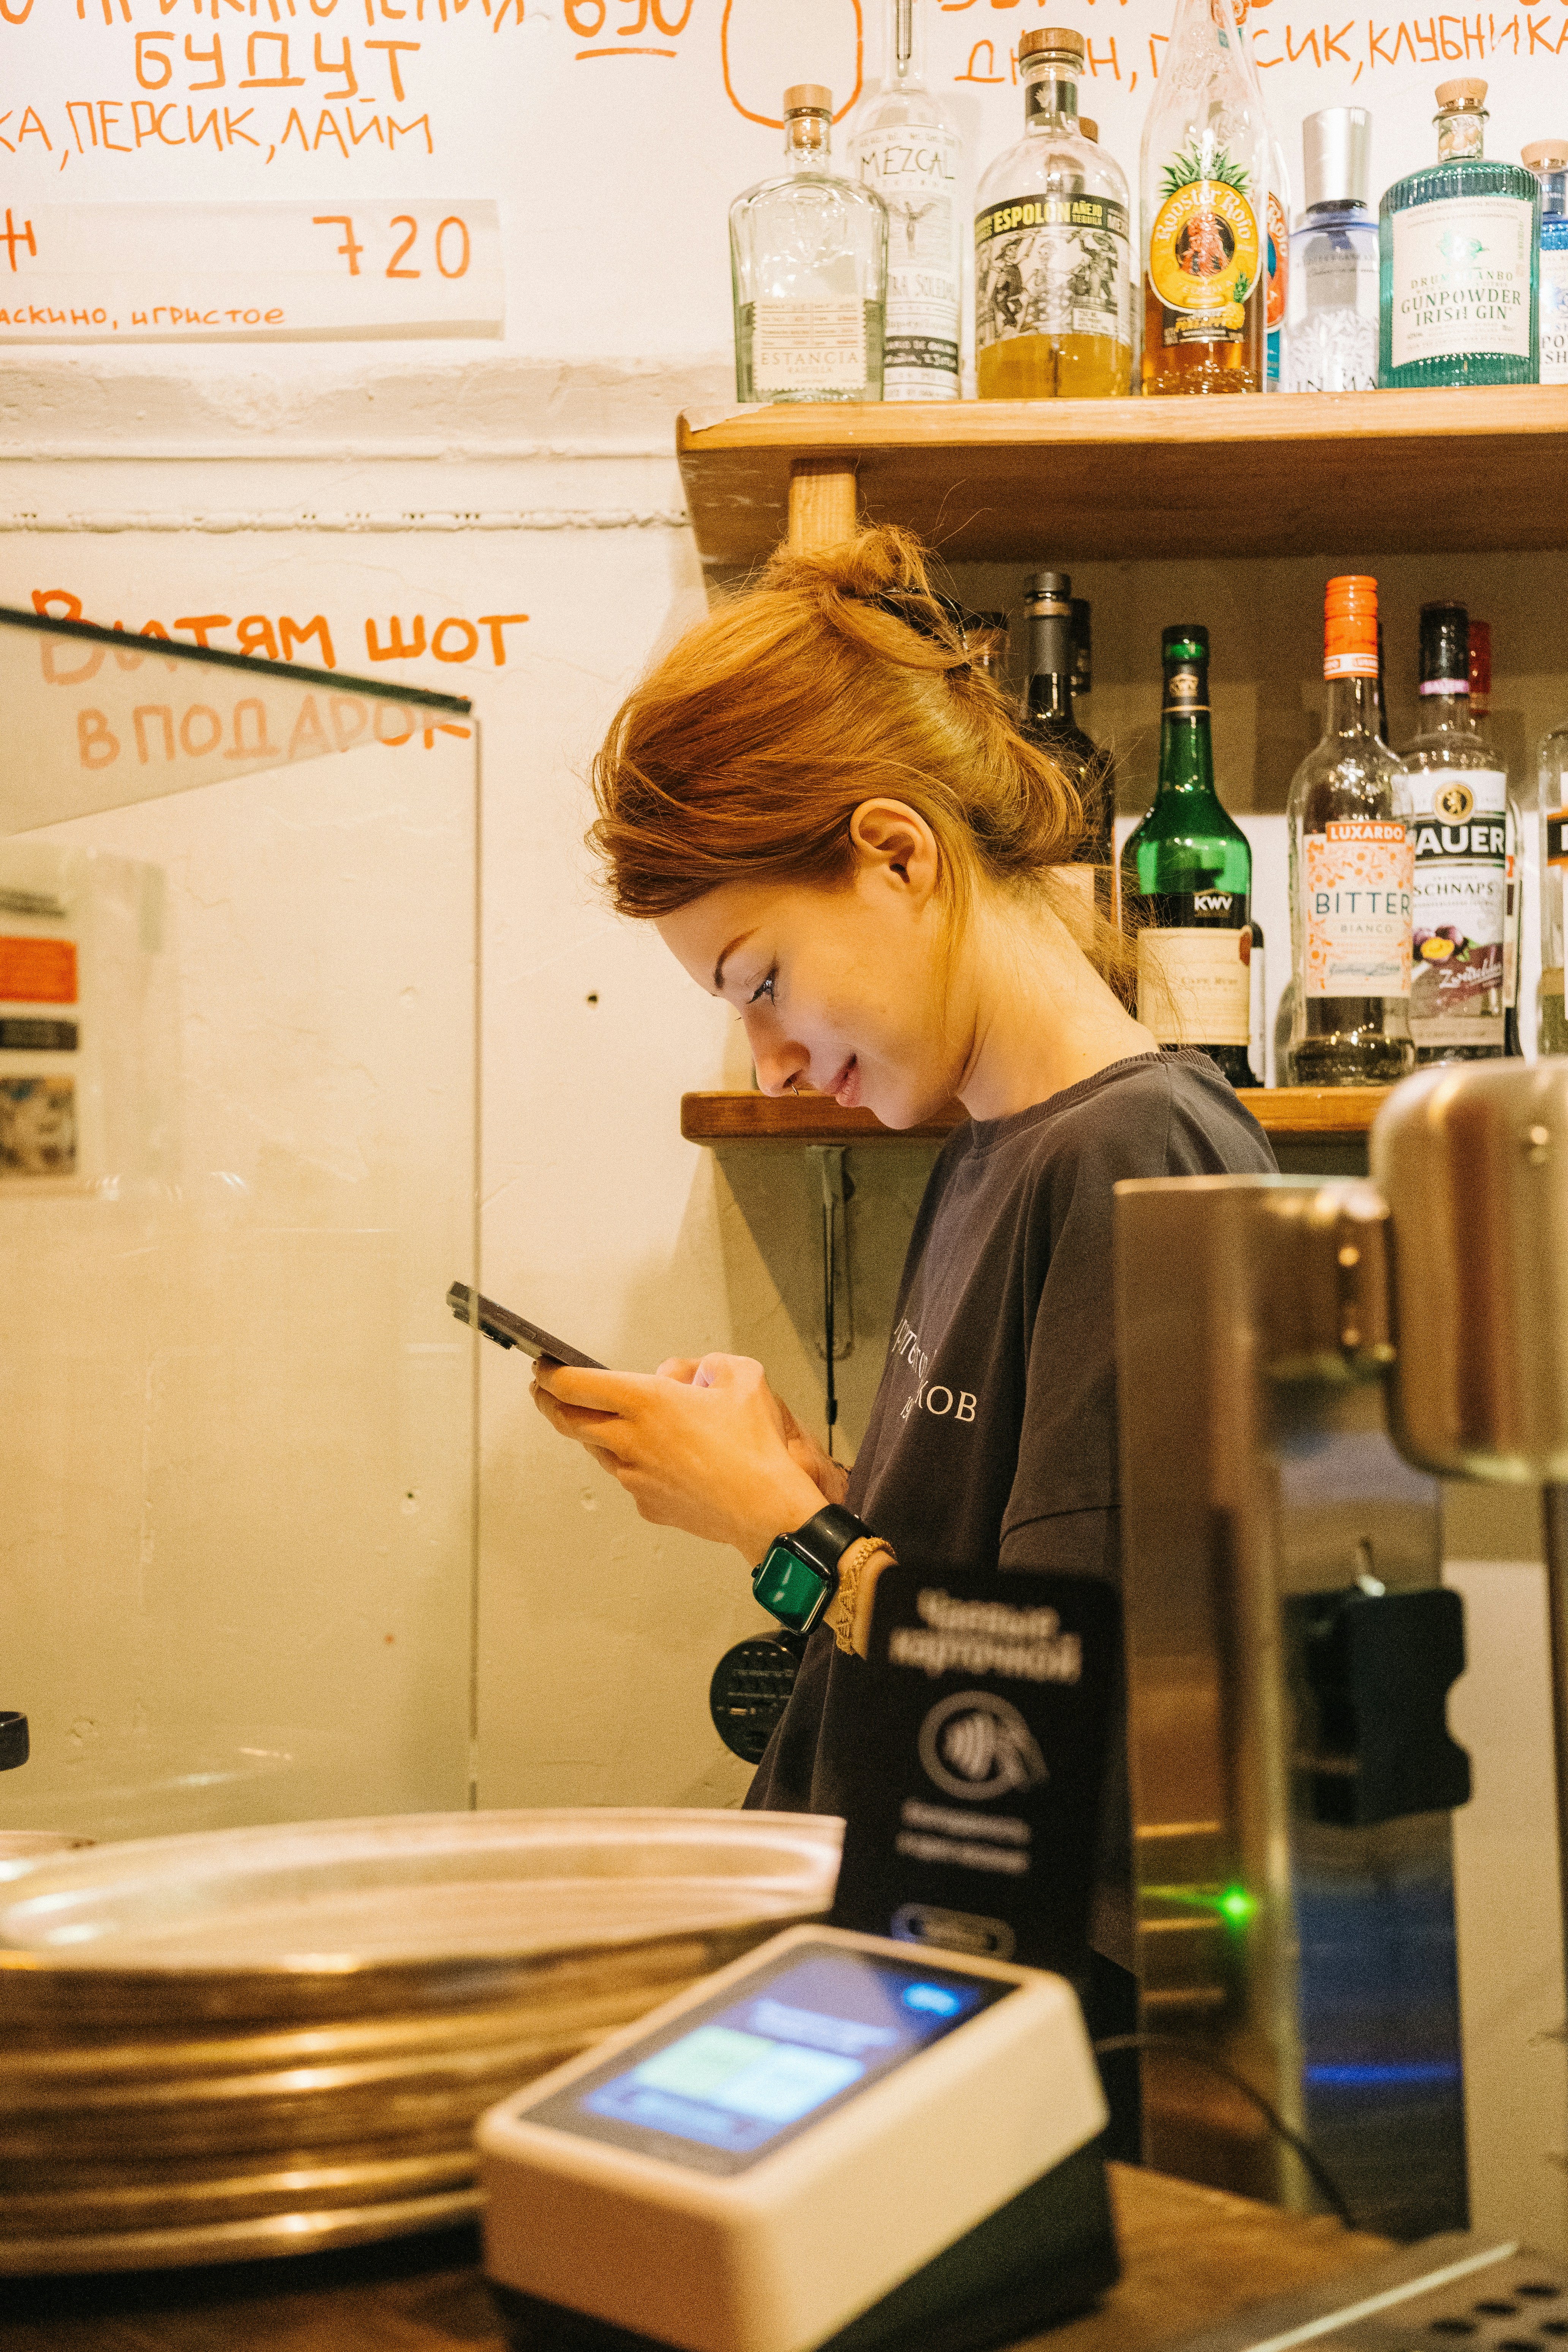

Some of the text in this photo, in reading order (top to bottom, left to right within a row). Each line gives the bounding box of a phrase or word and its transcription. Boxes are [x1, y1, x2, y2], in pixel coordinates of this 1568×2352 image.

[135, 31, 420, 101] БУДУТ
[859, 145, 955, 182] MEZCAL
[1073, 200, 1102, 217] AÑEJO
[313, 215, 470, 279] 720
[1400, 289, 1522, 315] GUNPOWDER
[1415, 305, 1508, 327] IRISH GIN
[760, 351, 859, 366] ESTANCIA
[1330, 825, 1404, 841] LUXARDO
[1413, 882, 1494, 897] SCHNAPS
[1193, 895, 1233, 911] KWV
[1315, 891, 1411, 916] BITTER
[1340, 924, 1394, 934] BIANCO
